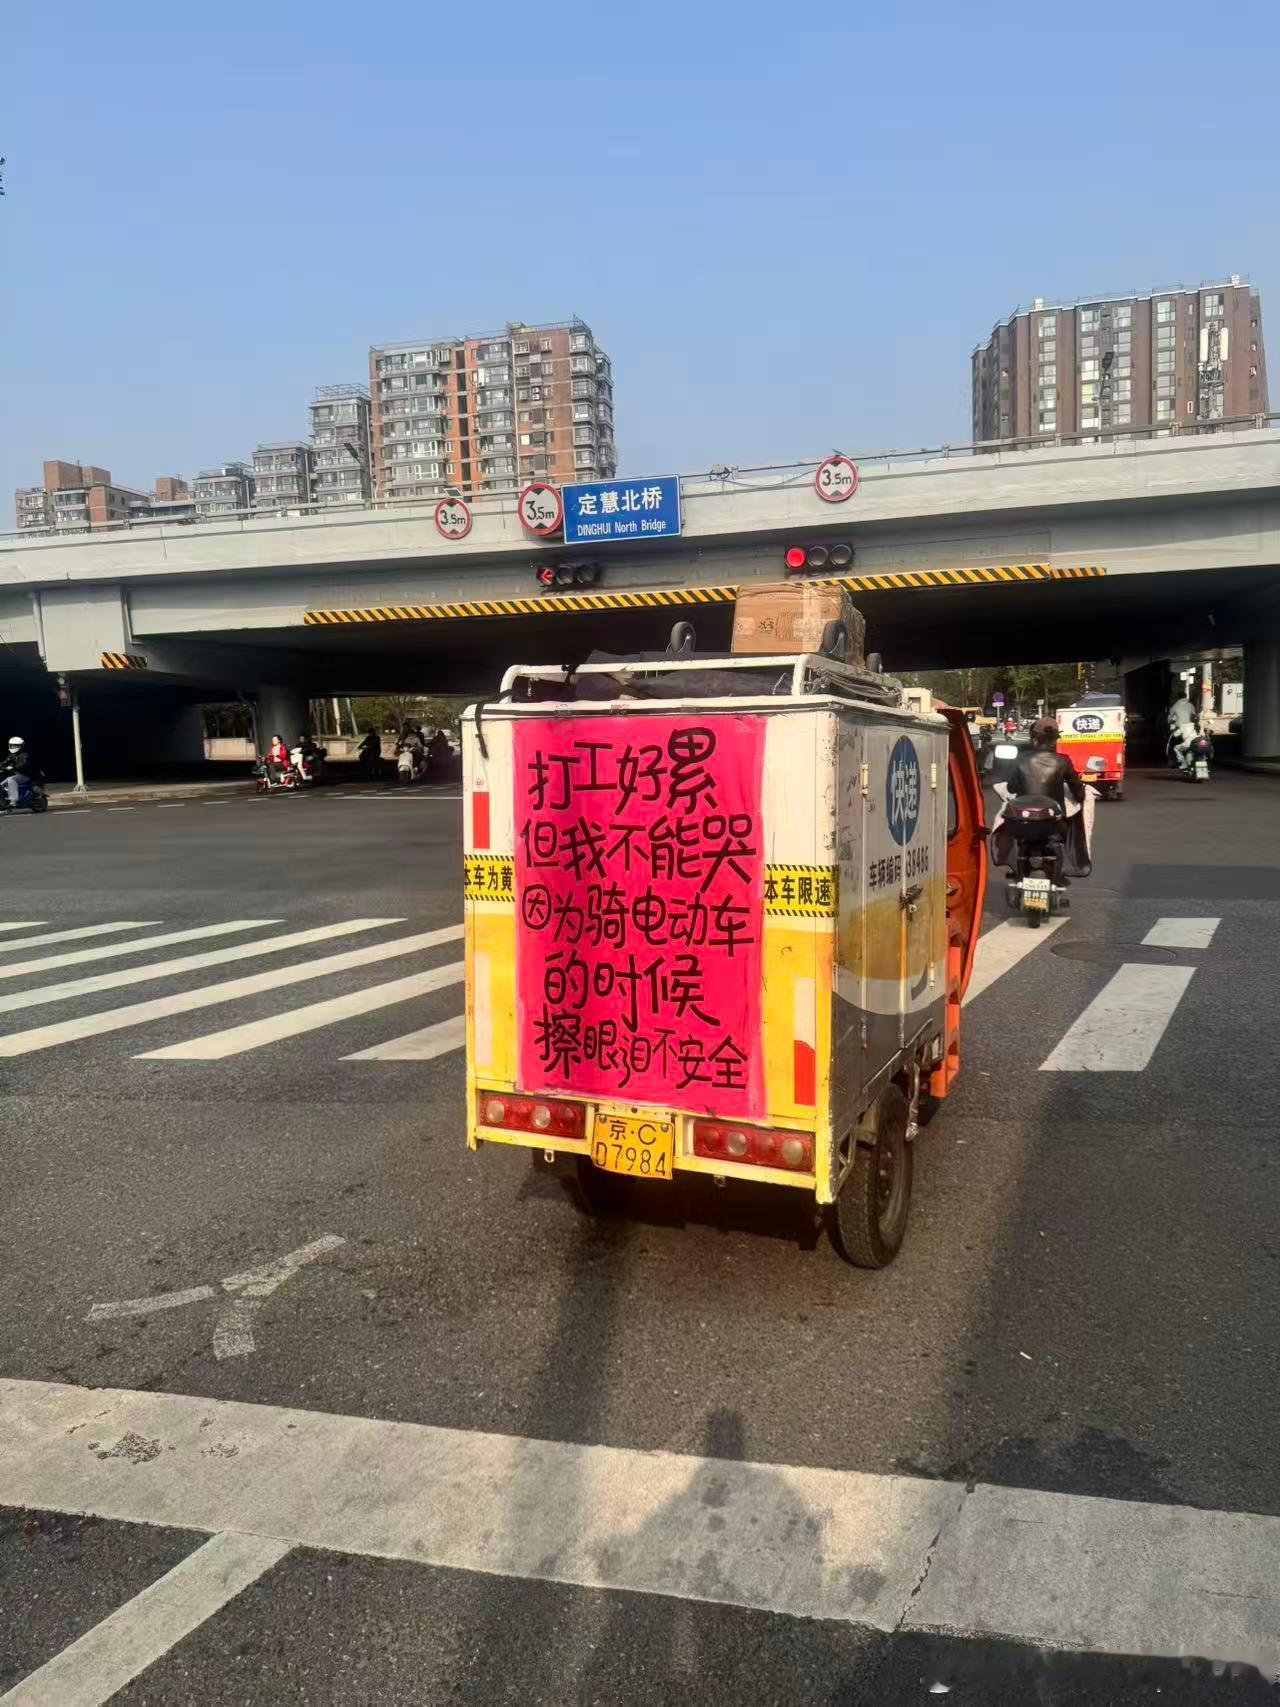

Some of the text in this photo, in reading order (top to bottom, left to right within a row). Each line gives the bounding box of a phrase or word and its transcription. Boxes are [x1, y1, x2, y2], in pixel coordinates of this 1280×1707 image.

[822, 469, 852, 486] 3.5m
[525, 500, 555, 520] 3.5m
[578, 486, 663, 516] 定慧北桥
[440, 509, 466, 526] 3.5m
[577, 518, 667, 537] DINGHUI North Bridge
[527, 727, 717, 816] 打工好累
[520, 813, 757, 893] 但我不能哭
[764, 872, 831, 906] 本车限速
[521, 883, 754, 957] 因为骑电动车
[543, 950, 721, 1032] 的时候
[533, 1003, 748, 1090] 擦眼泪不安全
[609, 1120, 657, 1146] 京·C
